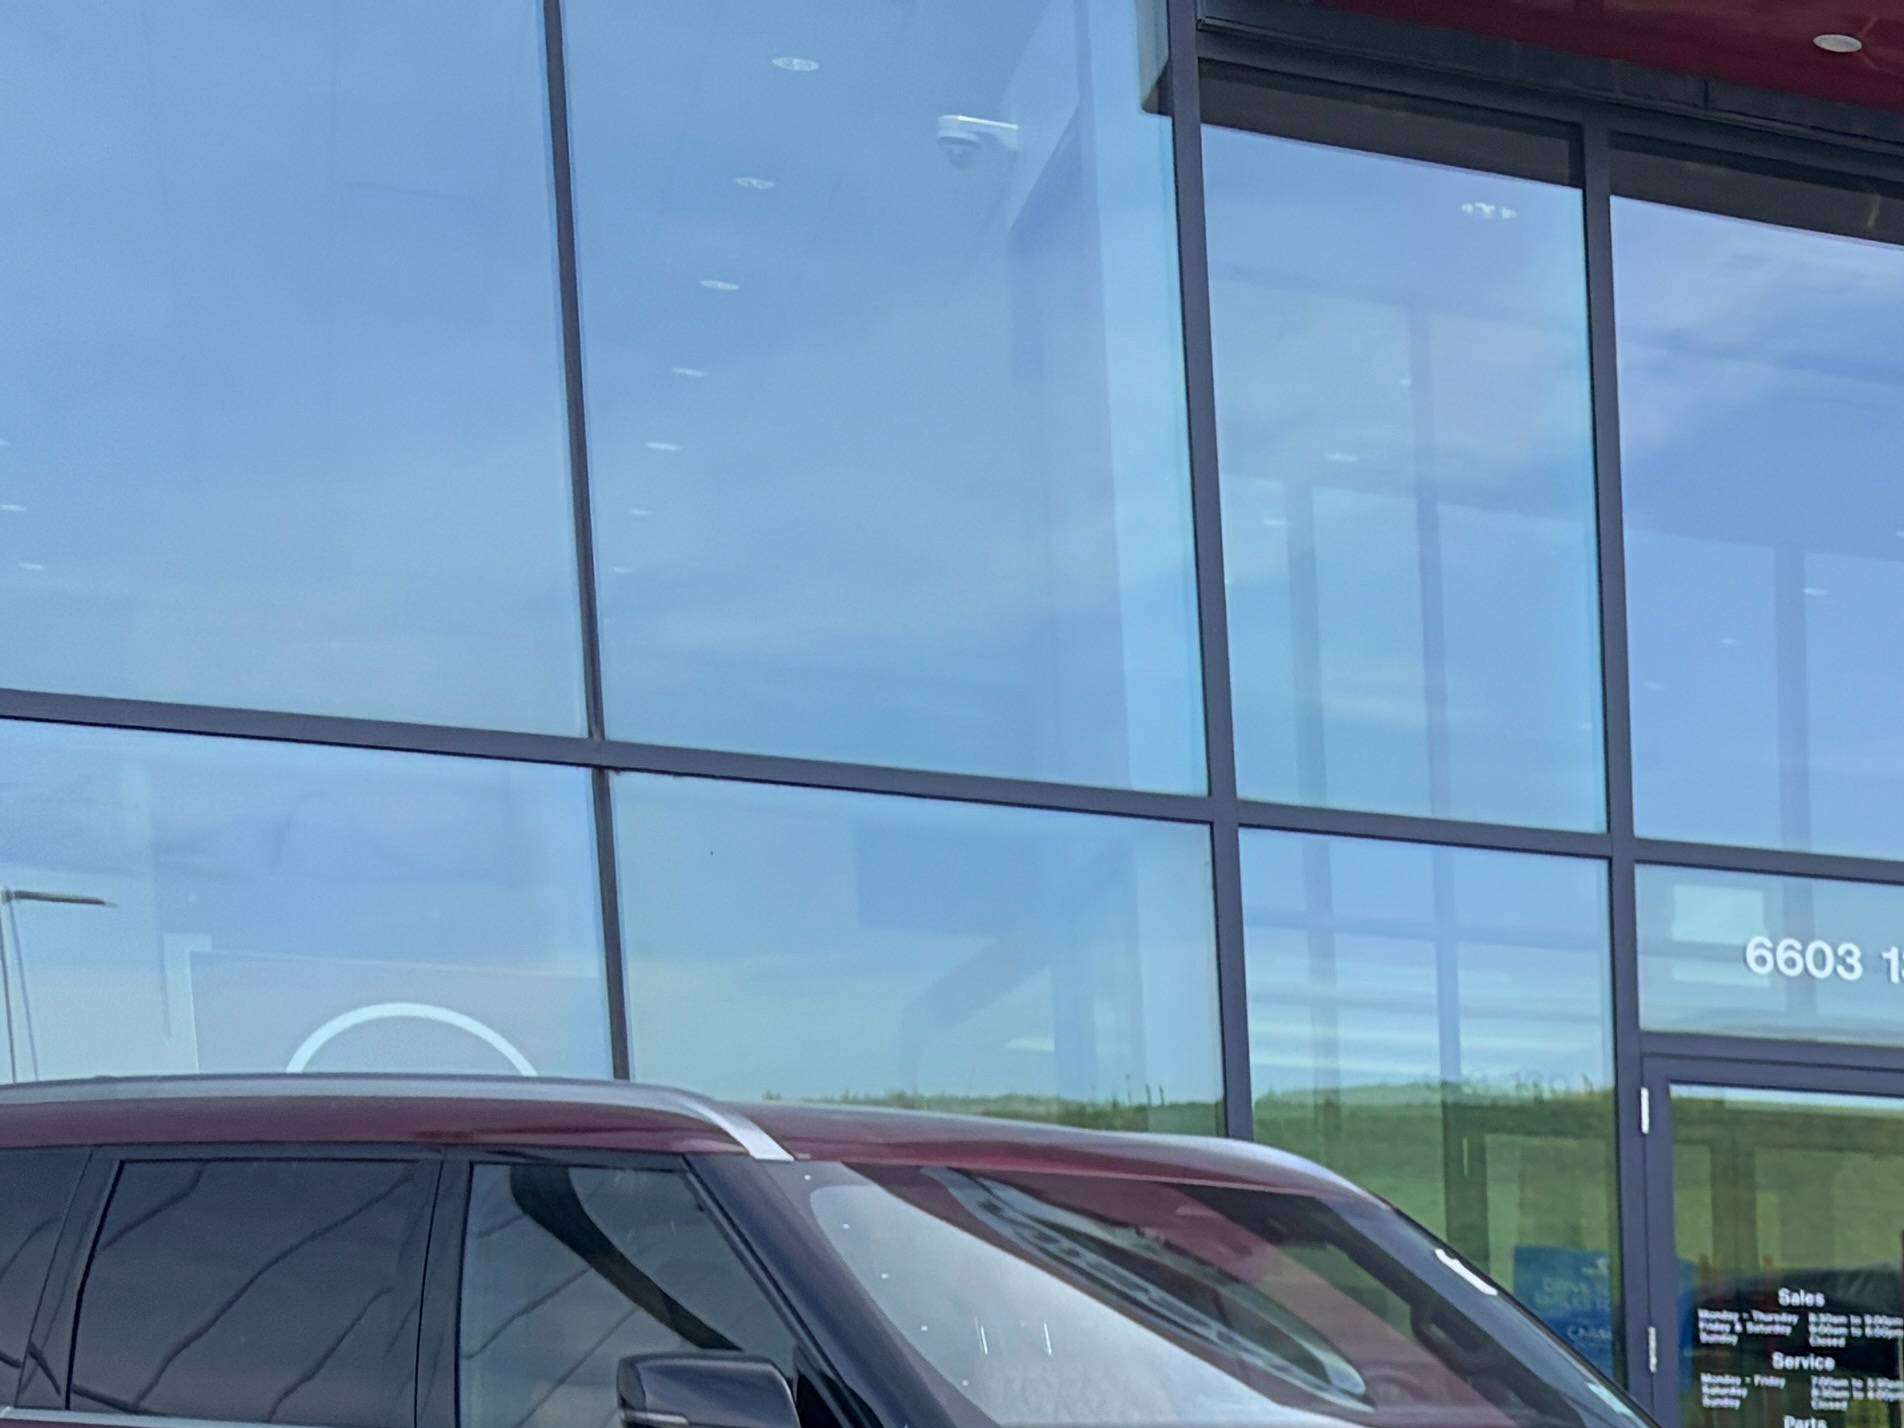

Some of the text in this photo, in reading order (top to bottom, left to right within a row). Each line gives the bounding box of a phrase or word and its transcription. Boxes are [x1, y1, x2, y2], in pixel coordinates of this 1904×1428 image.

[1745, 936, 1863, 981] 6603
[1778, 1287, 1826, 1308] Sales
[1809, 1334, 1846, 1348] Closed
[1772, 1351, 1836, 1372] Service
